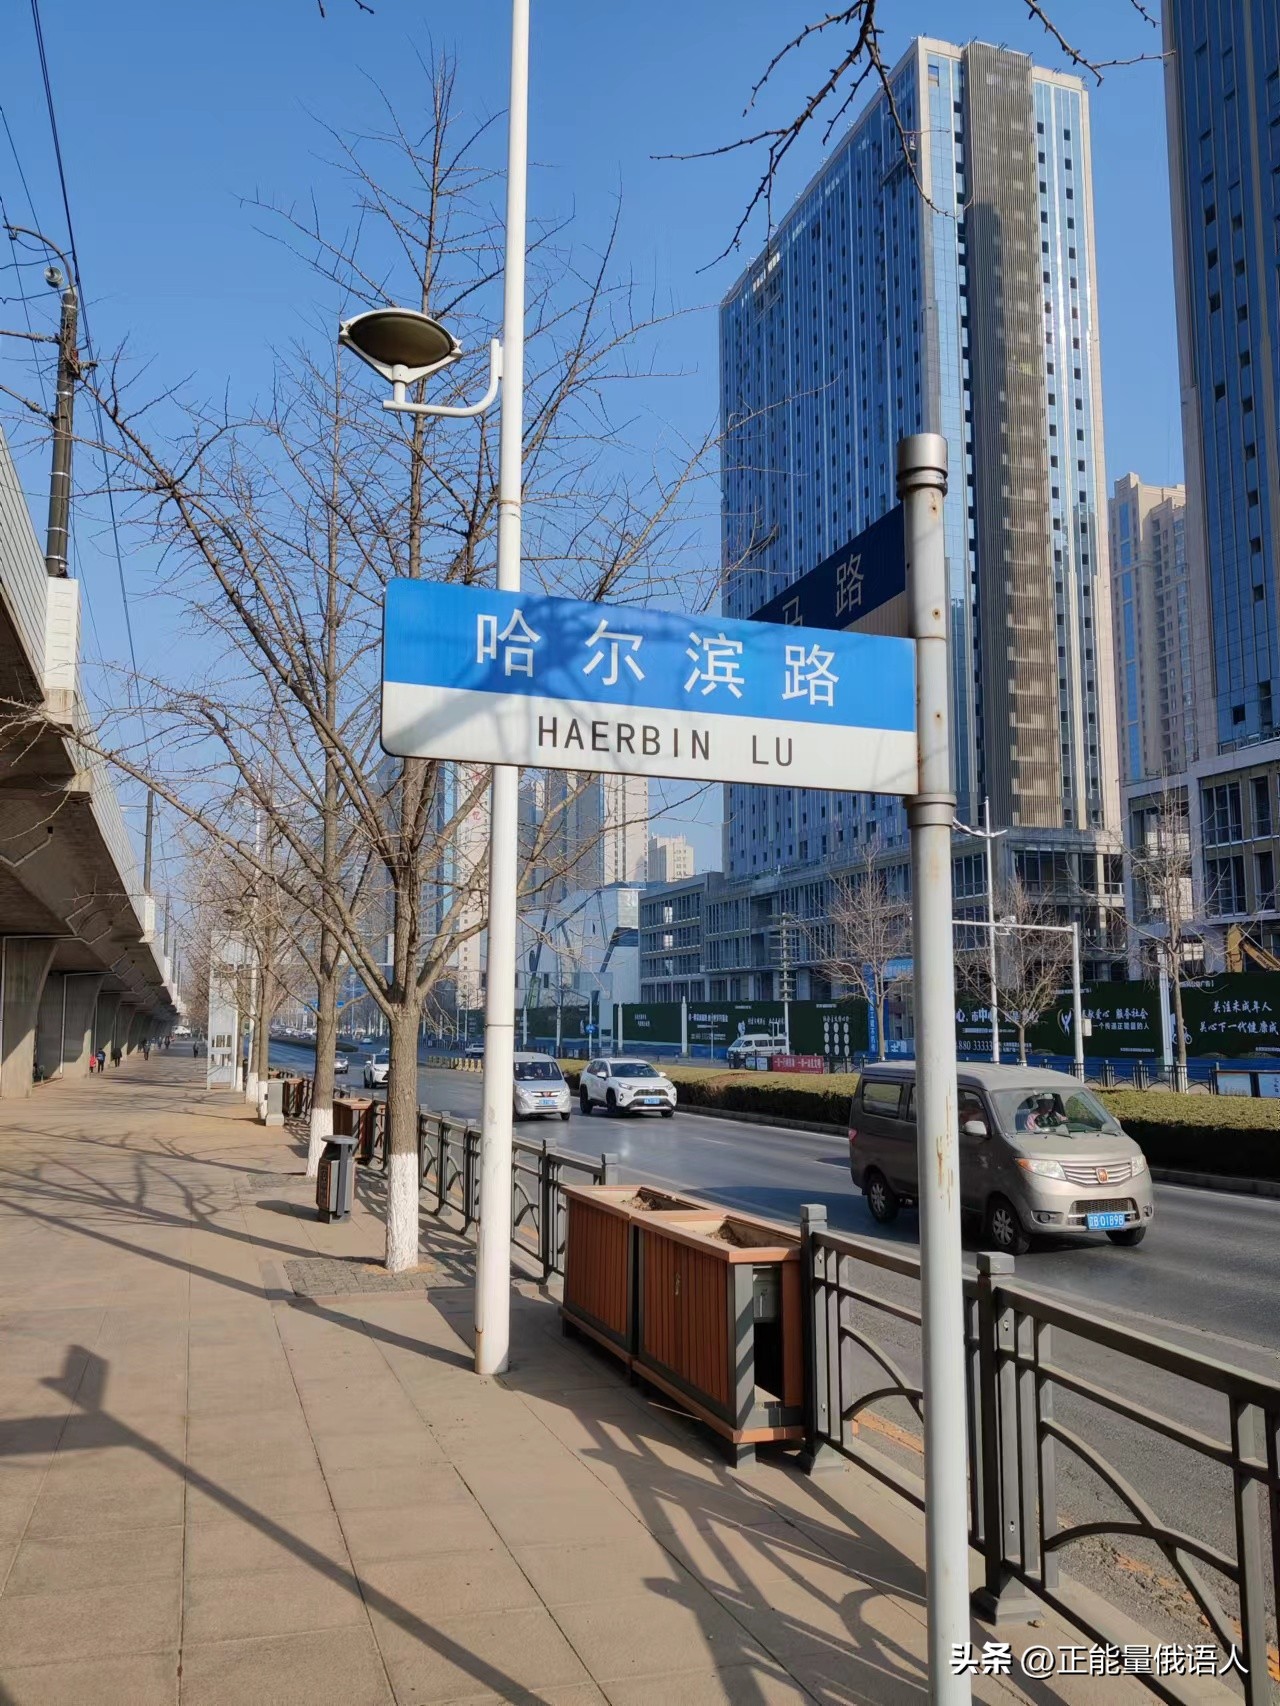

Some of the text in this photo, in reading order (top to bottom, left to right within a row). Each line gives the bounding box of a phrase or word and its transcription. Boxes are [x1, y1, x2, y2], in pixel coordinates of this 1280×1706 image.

[475, 607, 840, 708] 哈尔滨路
[537, 715, 794, 767] HAERBIN LU
